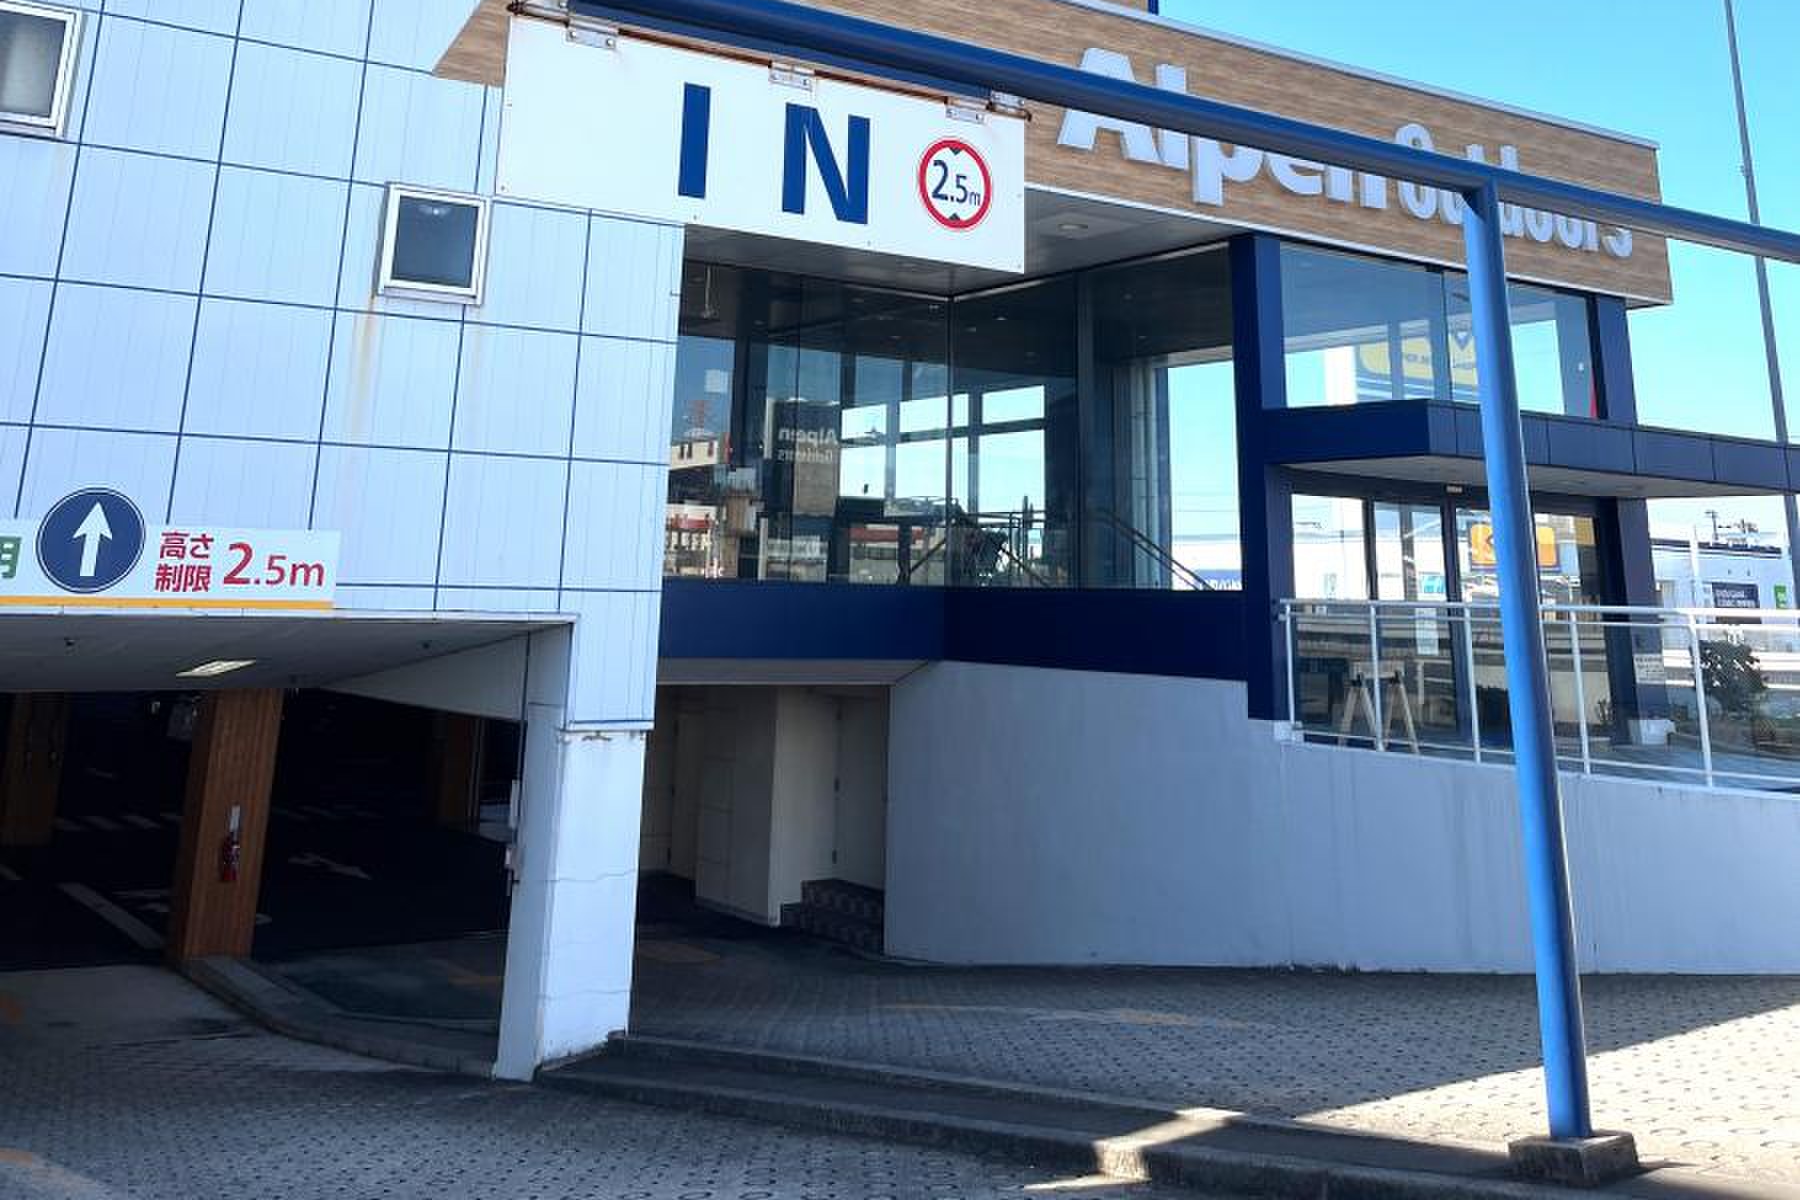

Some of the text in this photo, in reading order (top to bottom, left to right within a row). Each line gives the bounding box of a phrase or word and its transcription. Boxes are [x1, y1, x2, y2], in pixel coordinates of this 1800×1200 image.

[678, 82, 870, 225] IN
[931, 159, 981, 206] 2.5m
[160, 532, 214, 559] 高さ
[223, 542, 325, 587] 2.5m
[155, 563, 212, 593] 制限
